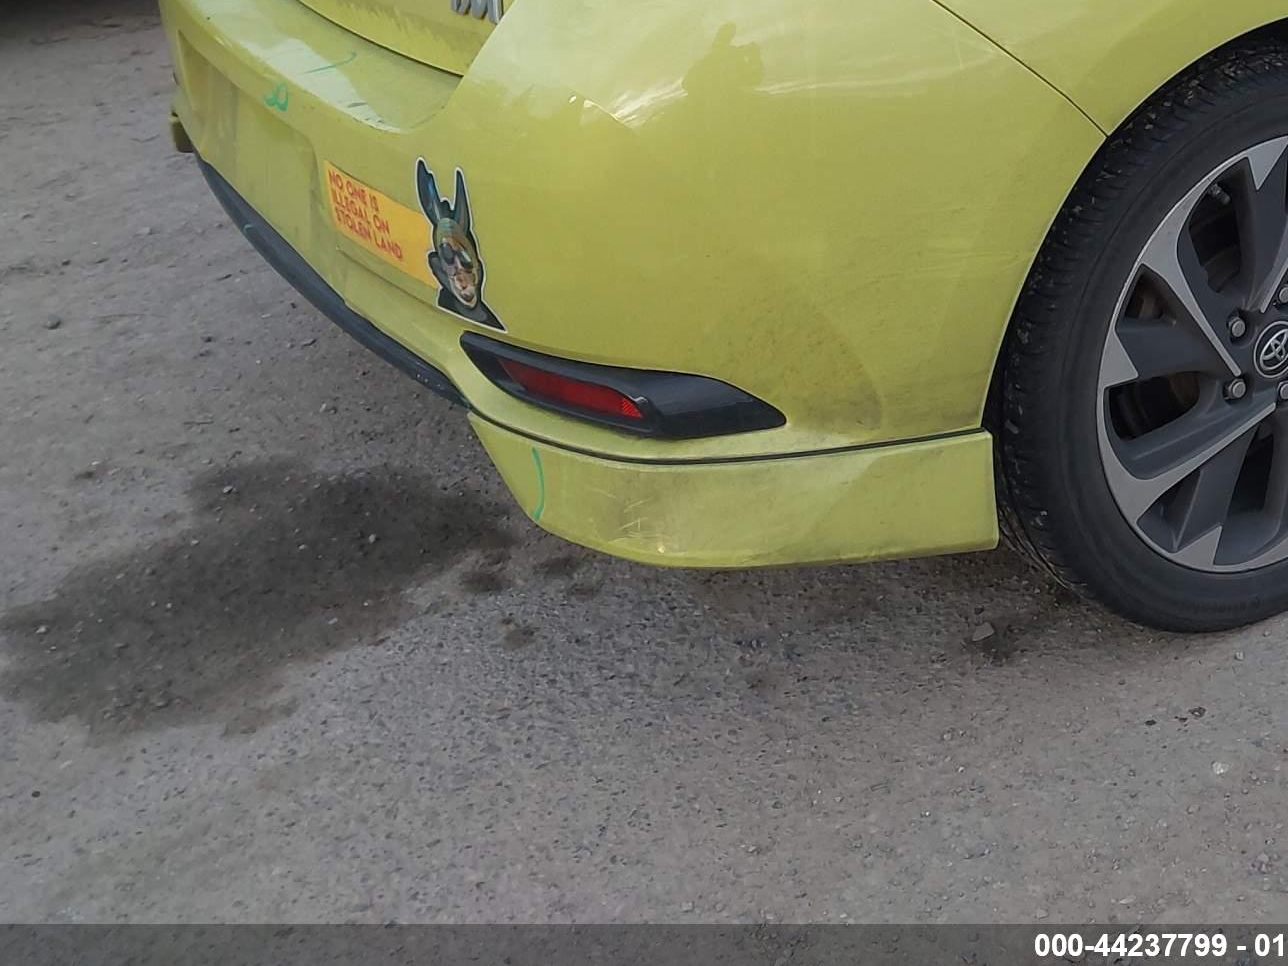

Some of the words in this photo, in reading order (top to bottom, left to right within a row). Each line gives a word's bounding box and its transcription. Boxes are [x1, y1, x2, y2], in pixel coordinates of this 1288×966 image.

[327, 169, 344, 190] NO
[346, 180, 368, 206] ONE
[369, 194, 380, 212] IS
[331, 188, 371, 226] ILLEGAL
[373, 214, 391, 235] ON
[335, 205, 372, 241] STOLEN
[373, 230, 404, 260] LAND
